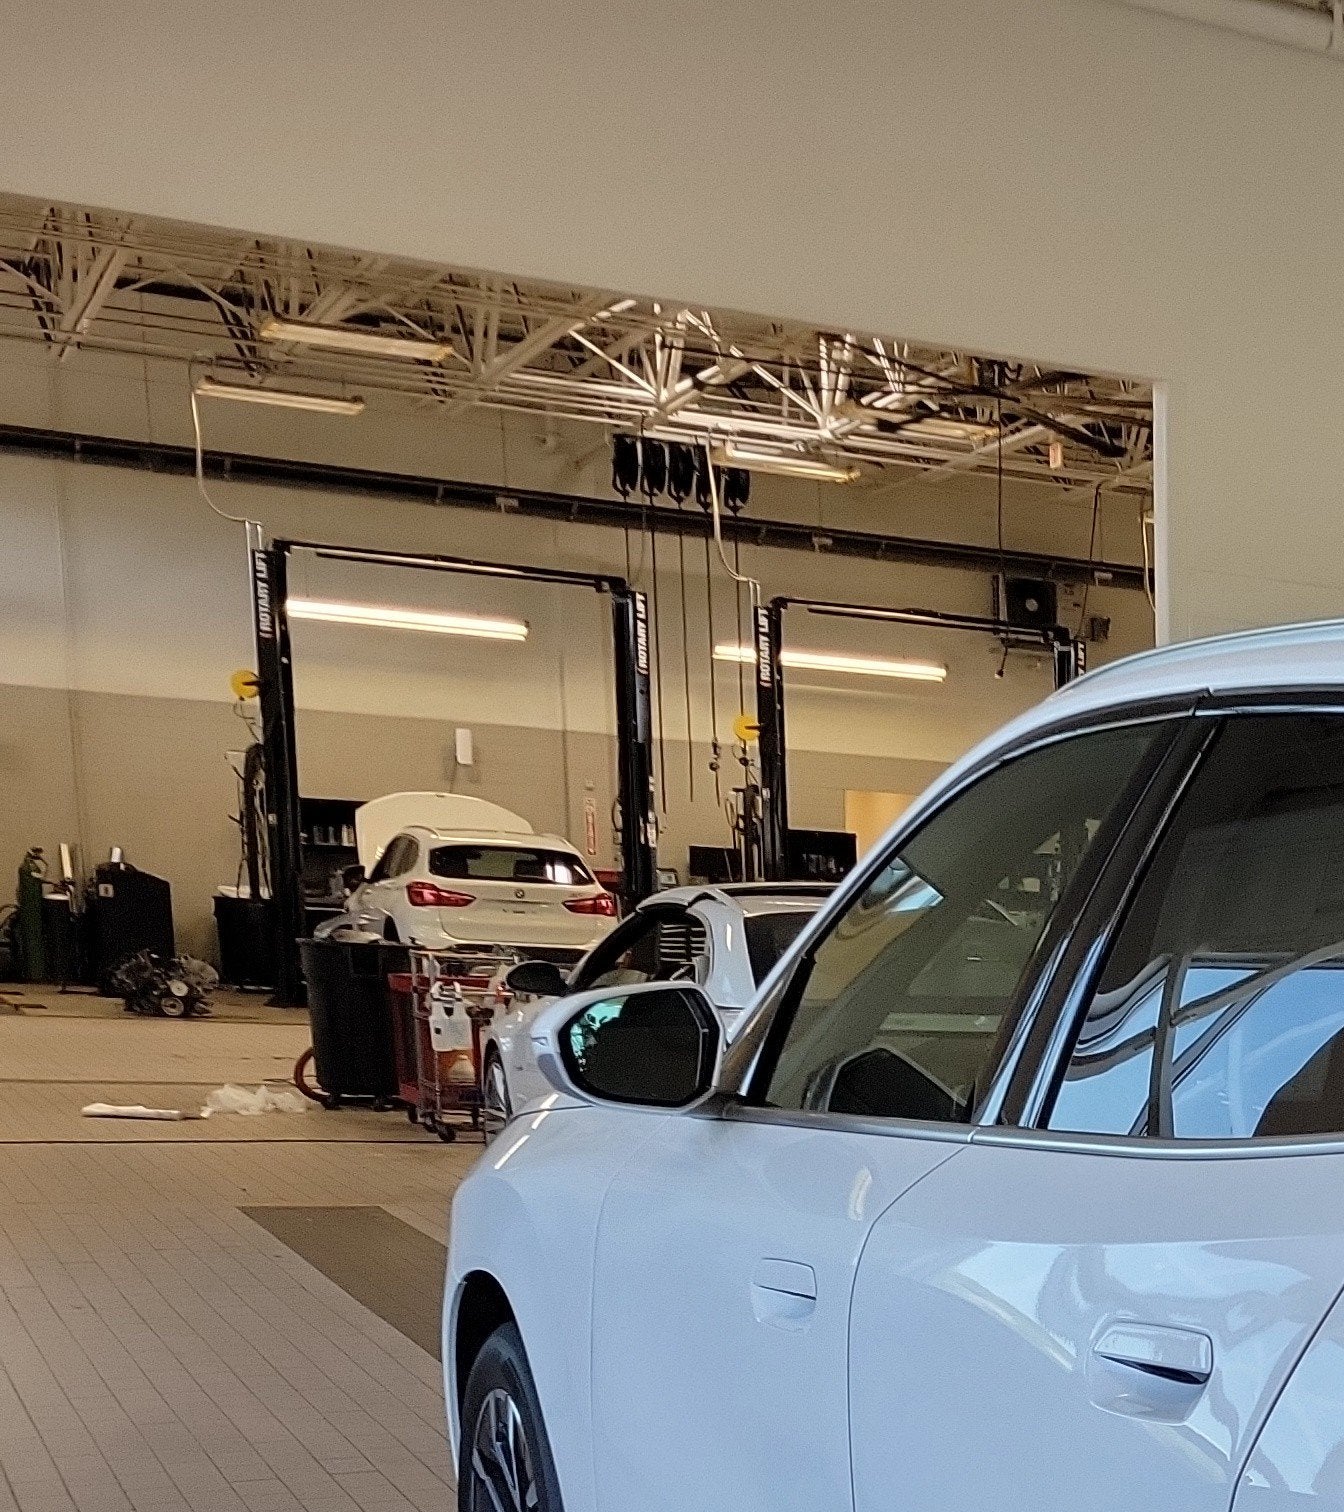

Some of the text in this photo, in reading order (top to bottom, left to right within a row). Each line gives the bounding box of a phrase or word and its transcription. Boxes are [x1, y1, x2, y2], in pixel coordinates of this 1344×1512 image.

[255, 551, 272, 631] ROTARY LIFT
[635, 592, 646, 619] LIFT
[758, 607, 769, 632] LIFT
